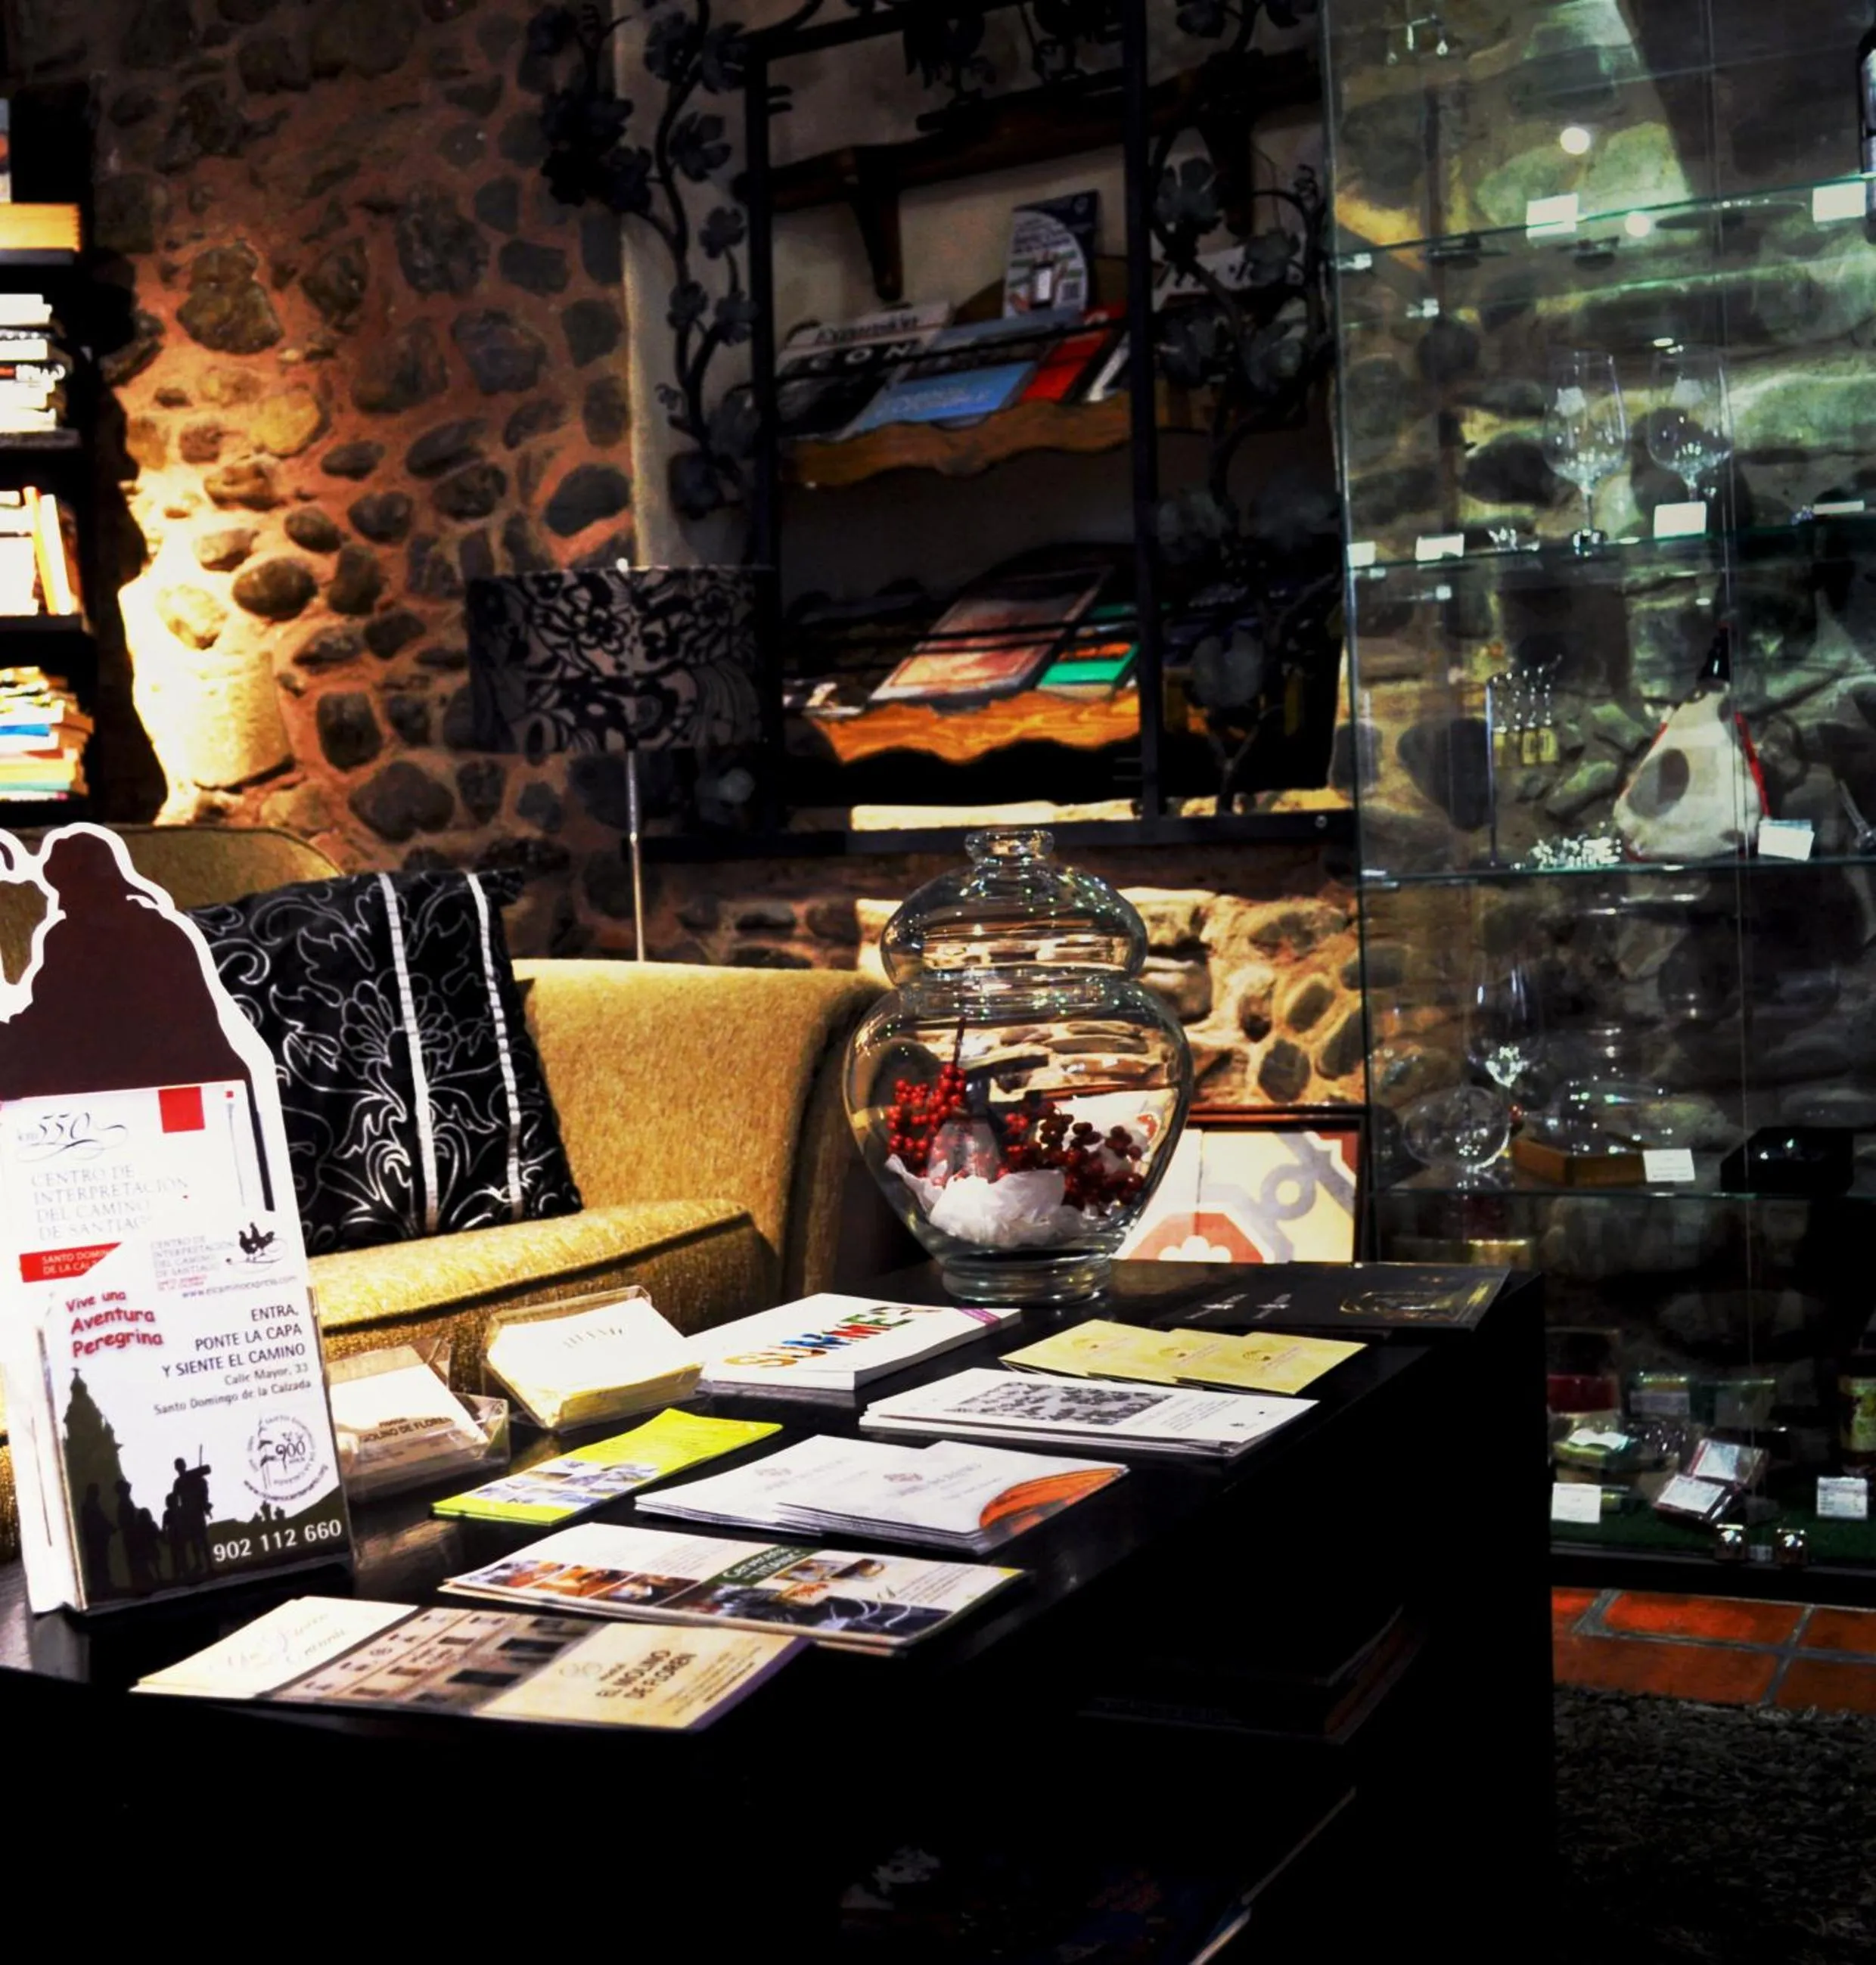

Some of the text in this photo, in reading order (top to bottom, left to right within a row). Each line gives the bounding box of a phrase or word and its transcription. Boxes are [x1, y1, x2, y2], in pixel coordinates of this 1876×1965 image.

[31, 1163, 135, 1187] CENTRO DE
[37, 1206, 70, 1224] DEL
[39, 1225, 63, 1241] DE
[66, 1290, 126, 1313] Vive una
[70, 1307, 157, 1334] Aventura
[72, 1330, 164, 1358] Peregrina
[195, 1323, 303, 1352] PONTE LA CAPA
[161, 1342, 306, 1379] Y SIENTE EL CAMINO
[225, 1371, 251, 1387] Calle
[154, 1379, 312, 1416] Santo Domingo de la Calzada
[275, 1440, 306, 1472] 900
[213, 1519, 342, 1562] 902 112 660
